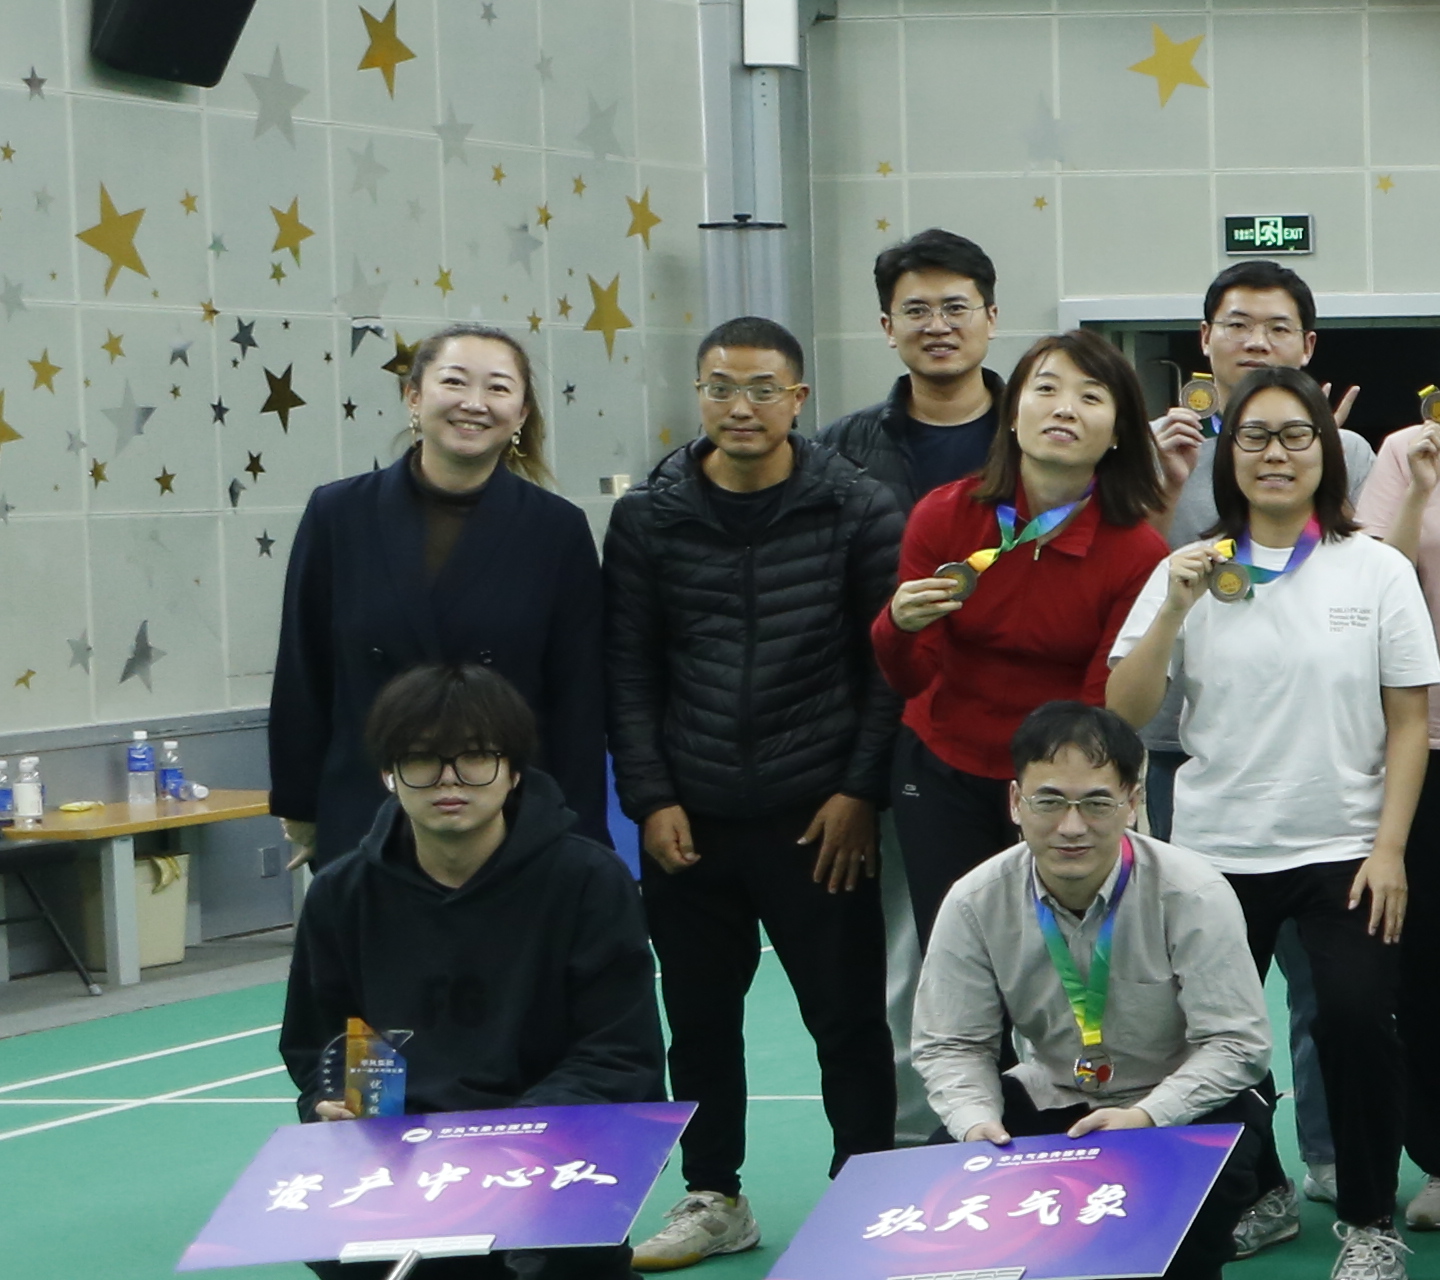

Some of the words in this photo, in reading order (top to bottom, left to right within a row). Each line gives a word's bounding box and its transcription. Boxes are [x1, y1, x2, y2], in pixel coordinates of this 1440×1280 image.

[1284, 227, 1304, 239] EXIT
[266, 1160, 619, 1212] 资产中心队
